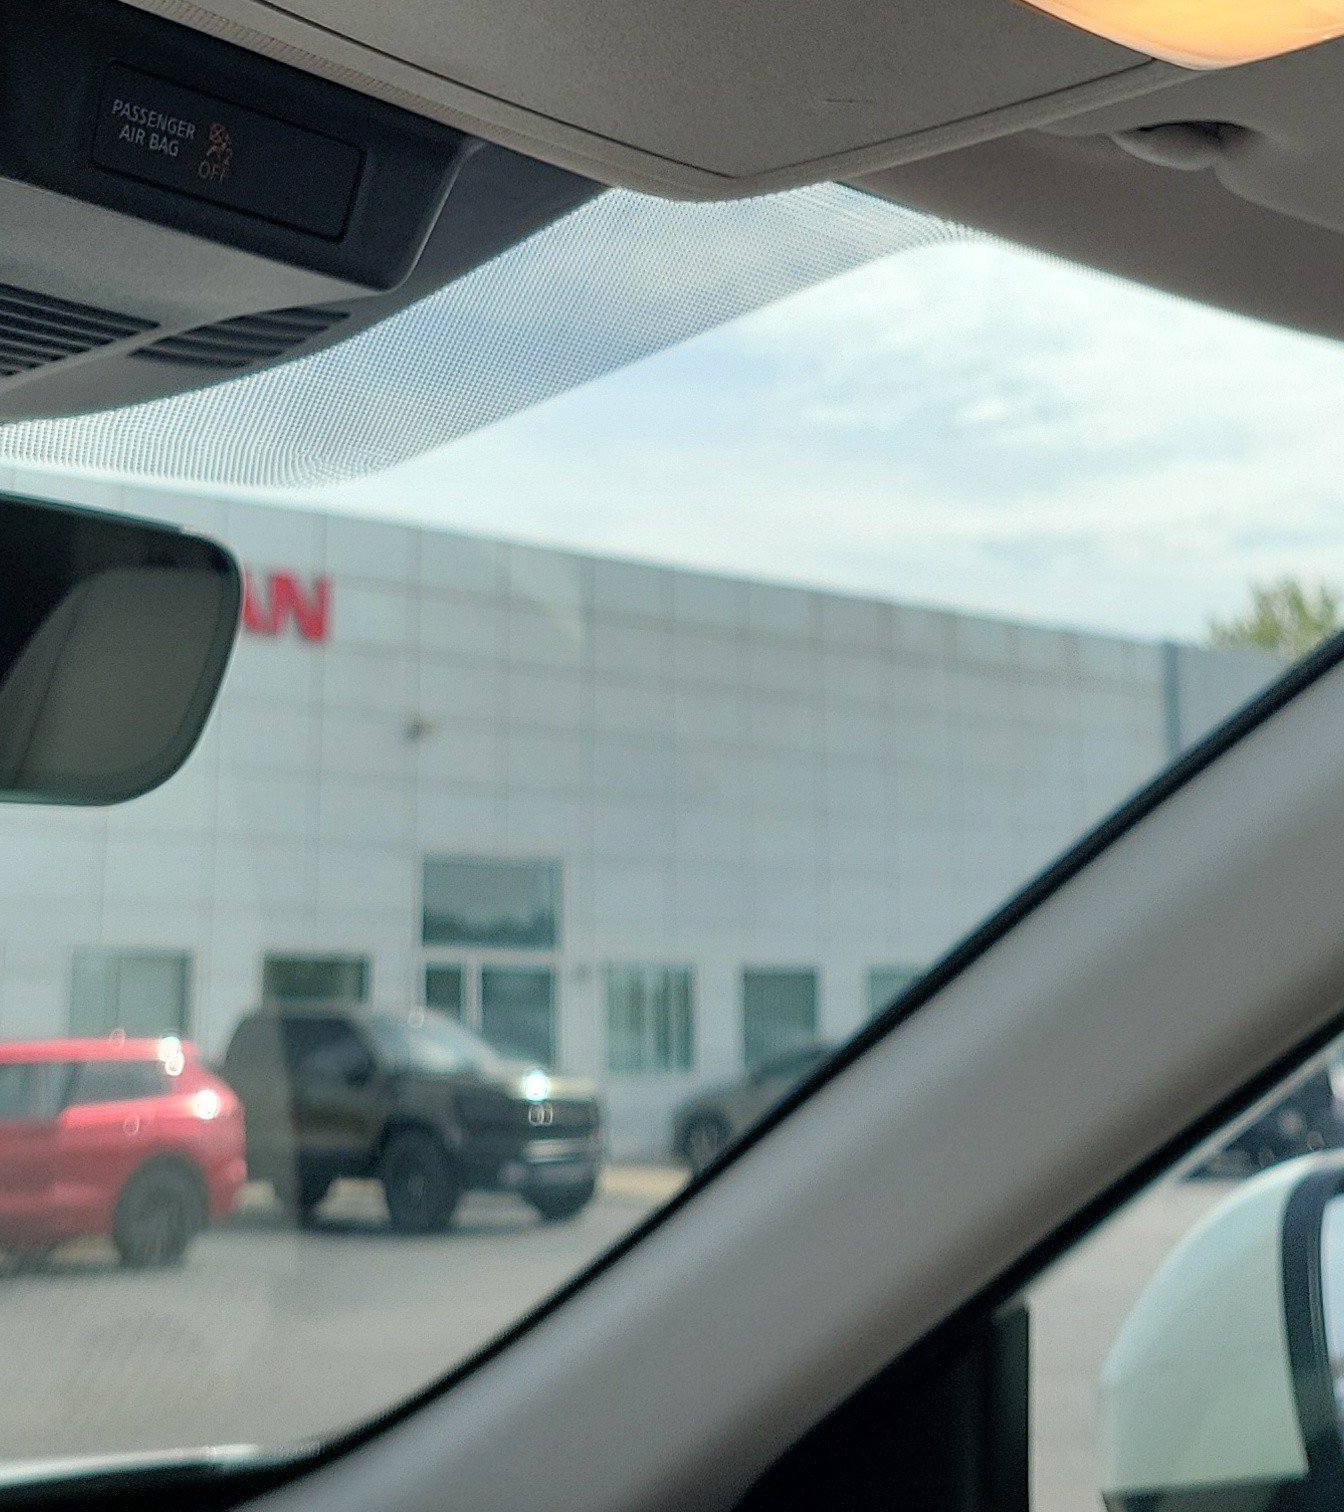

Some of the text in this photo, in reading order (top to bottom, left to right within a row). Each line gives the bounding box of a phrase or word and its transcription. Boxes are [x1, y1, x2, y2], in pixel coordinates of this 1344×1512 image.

[112, 98, 197, 140] PASSENGER
[119, 124, 180, 157] AIR BAG
